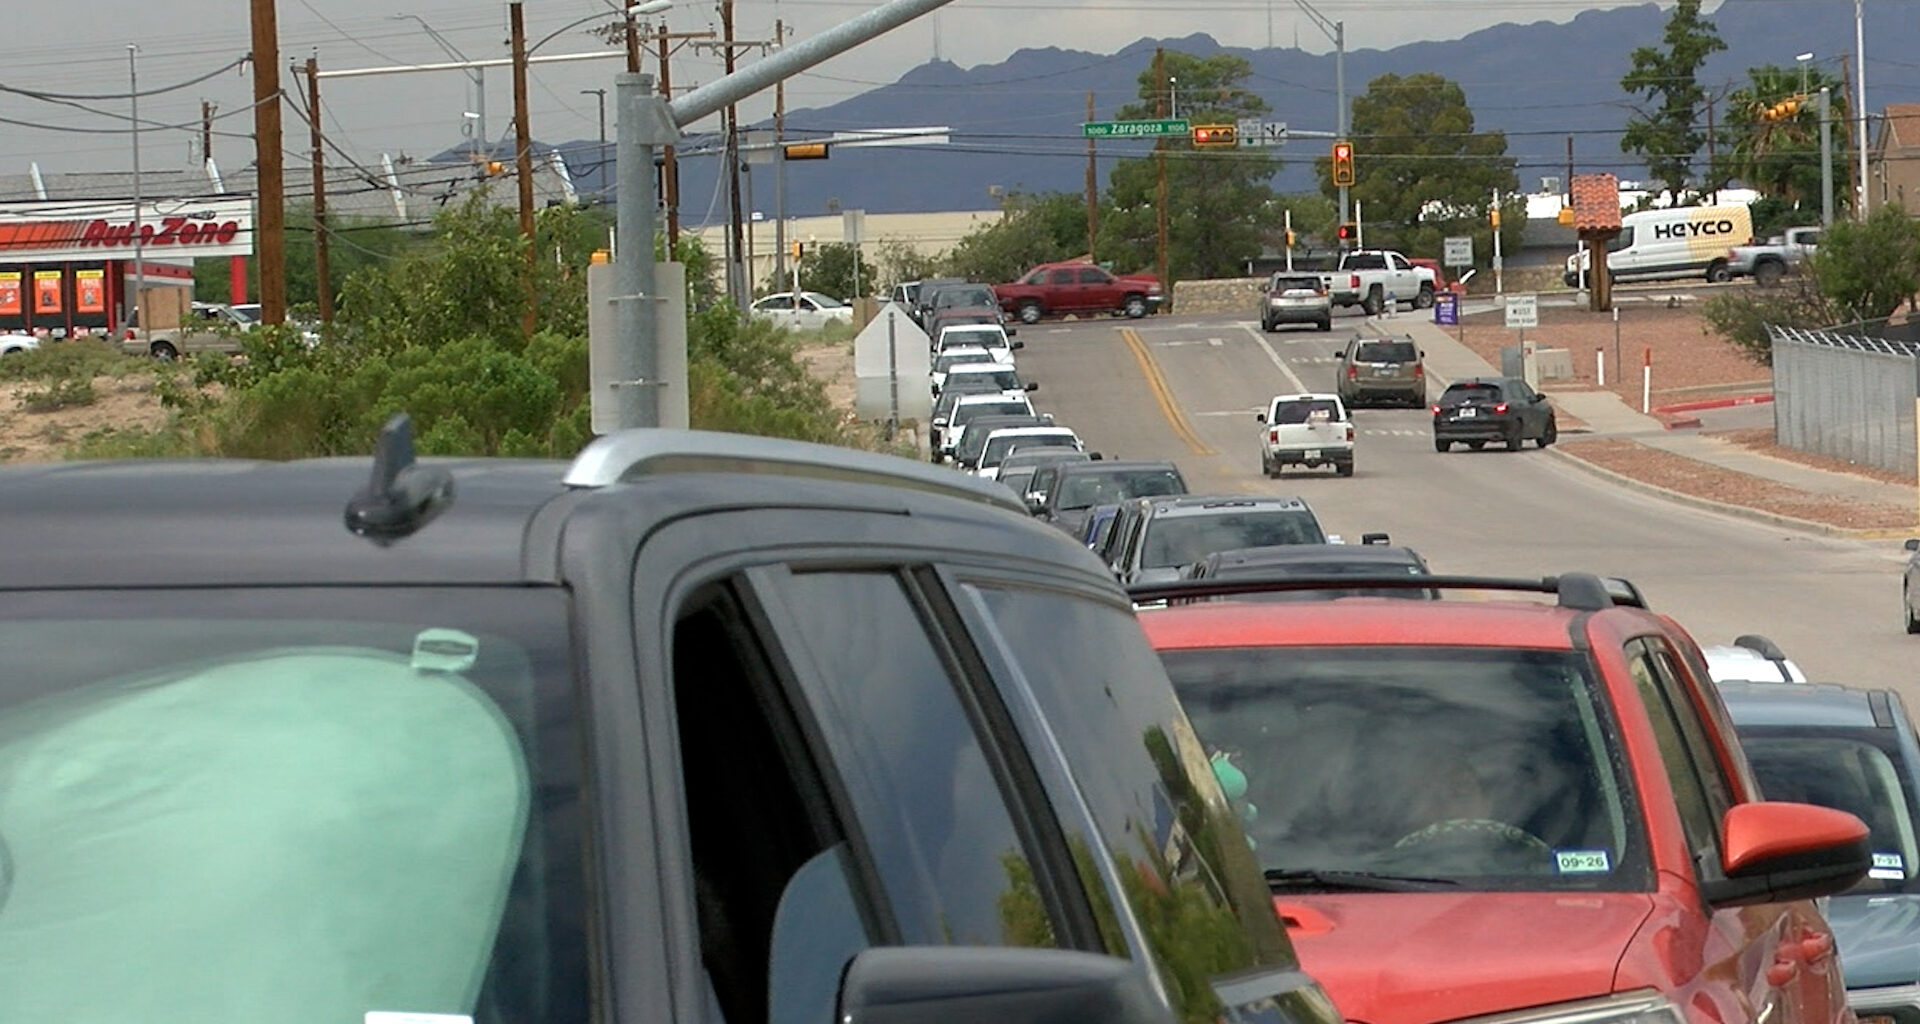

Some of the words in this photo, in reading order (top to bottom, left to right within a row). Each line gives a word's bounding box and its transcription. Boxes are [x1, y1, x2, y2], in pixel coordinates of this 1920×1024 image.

[1111, 123, 1162, 136] Zaragoza
[79, 217, 238, 247] AutoZone
[1654, 220, 1733, 239] HEYCO
[1560, 855, 1605, 868] 09-26
